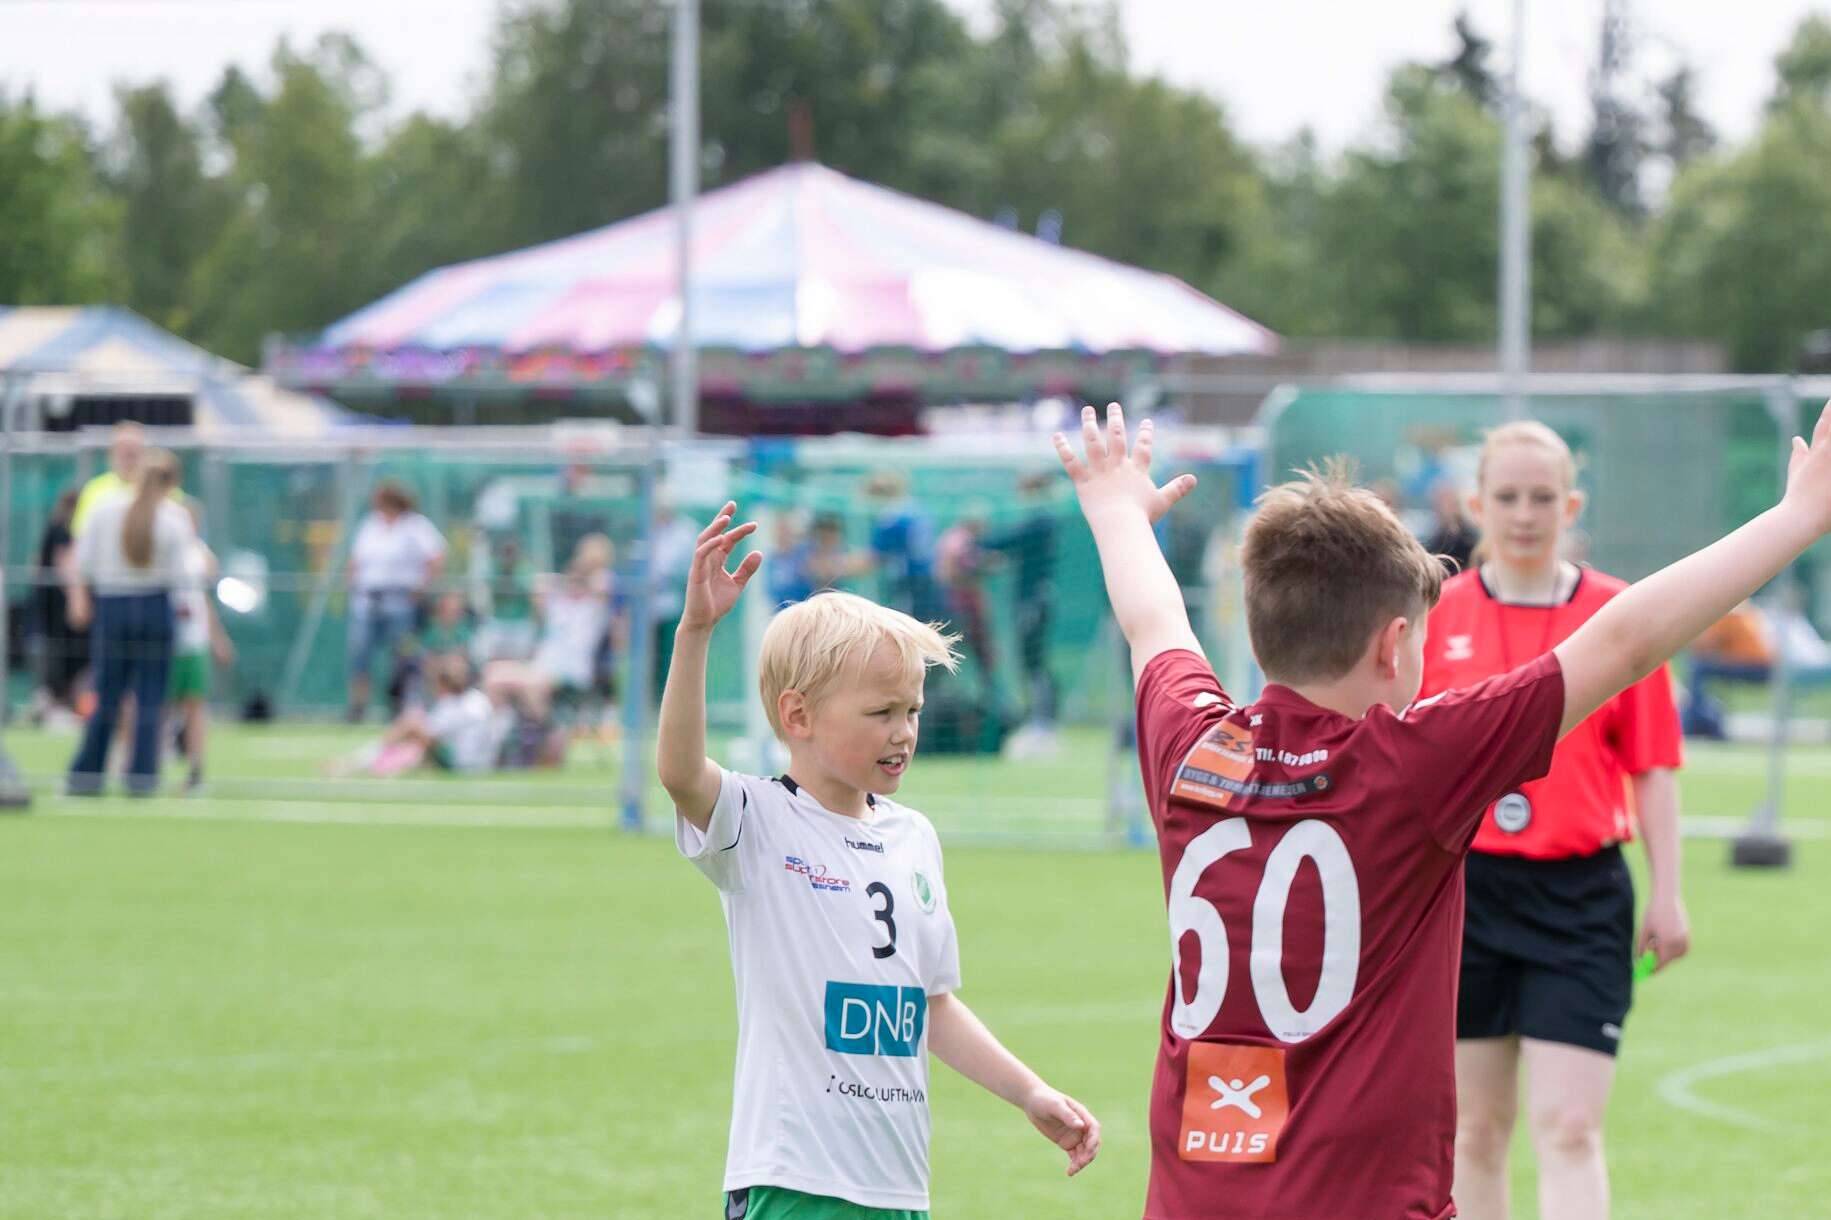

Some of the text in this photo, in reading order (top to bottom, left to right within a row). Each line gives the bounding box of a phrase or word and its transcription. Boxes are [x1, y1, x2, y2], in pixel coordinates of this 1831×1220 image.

[844, 836, 885, 853] hummel
[865, 881, 897, 959] 3
[1169, 817, 1361, 1044] 60
[840, 986, 917, 1057] DNB
